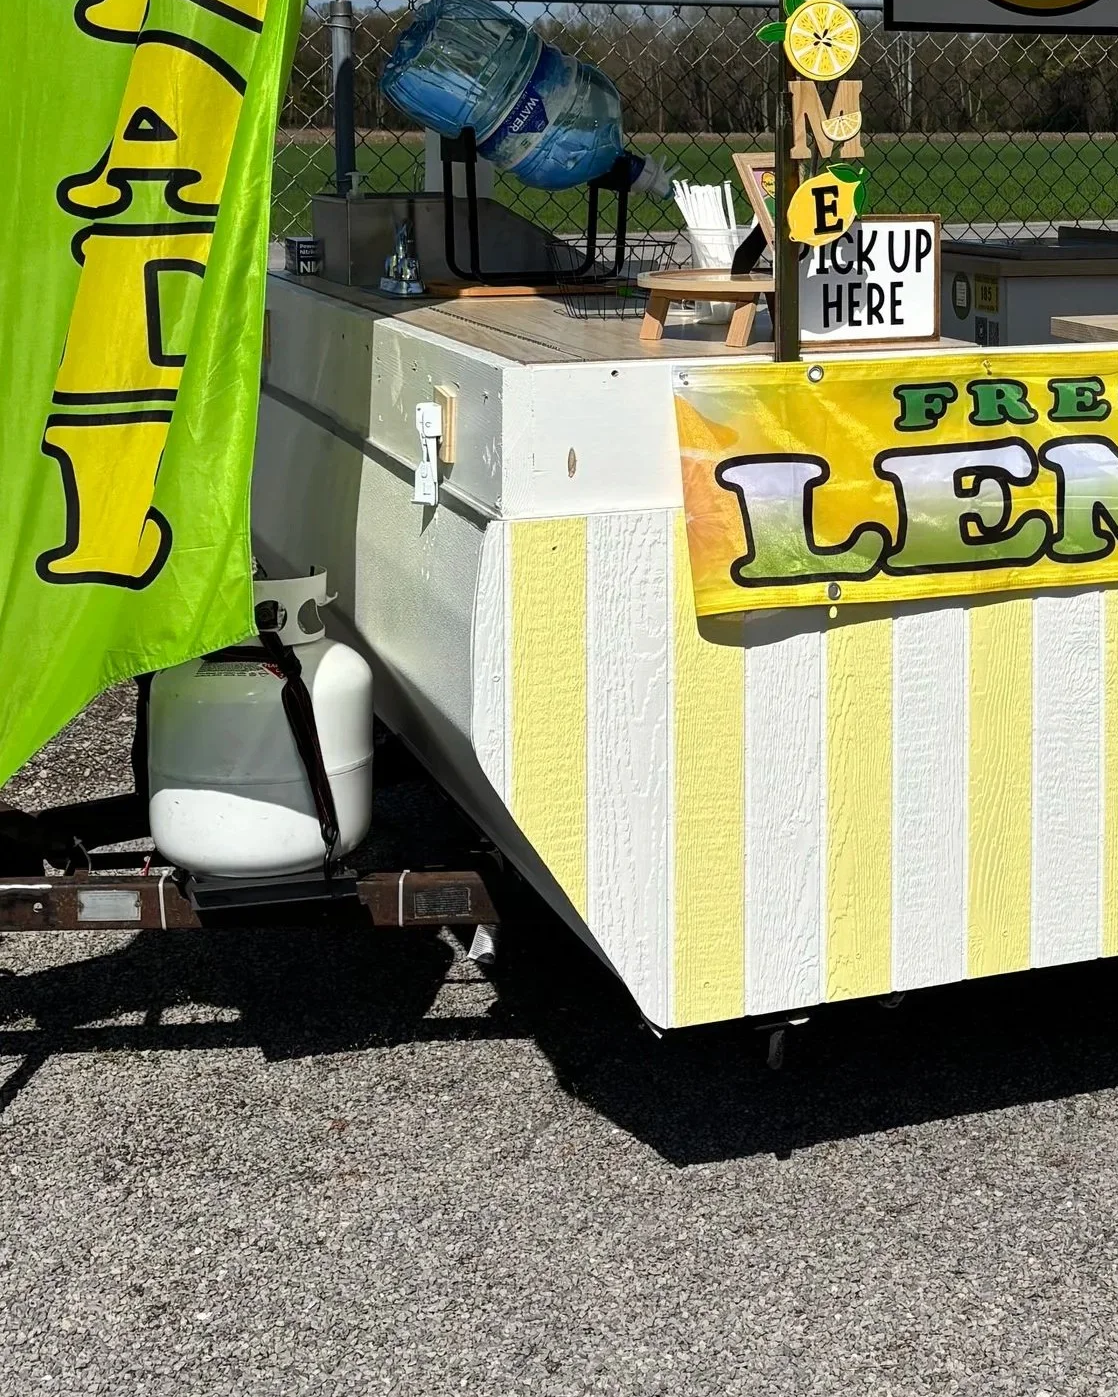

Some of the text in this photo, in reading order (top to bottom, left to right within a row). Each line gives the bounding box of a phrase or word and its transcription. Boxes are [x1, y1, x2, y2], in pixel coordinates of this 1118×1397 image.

[509, 97, 539, 133] WATER
[888, 228, 932, 273] UP
[822, 281, 904, 328] HERE
